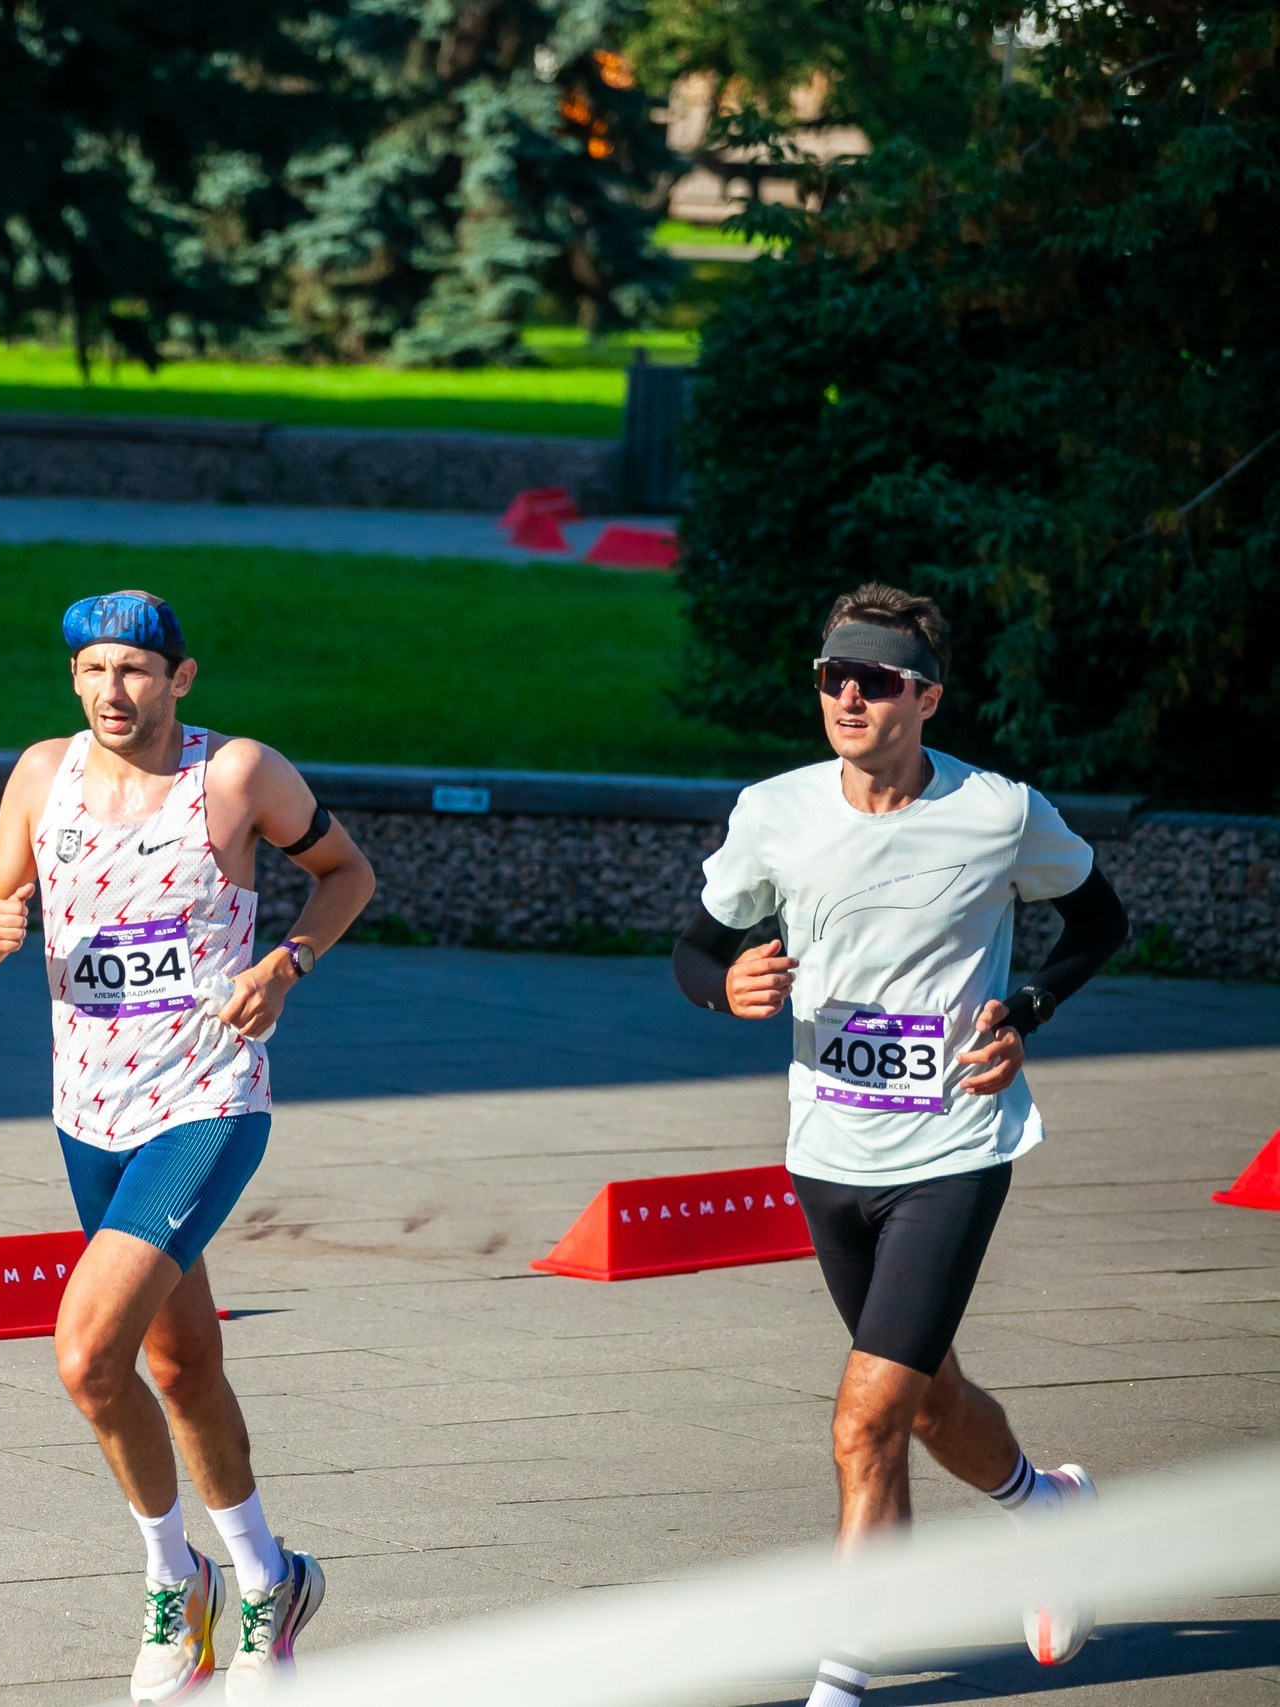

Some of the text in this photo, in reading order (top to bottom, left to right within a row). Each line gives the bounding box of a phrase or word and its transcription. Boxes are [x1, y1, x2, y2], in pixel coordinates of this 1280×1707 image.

[74, 947, 185, 989] 4034
[94, 987, 167, 999] КЛЕЗИС ВЛАДИМИР
[820, 1037, 937, 1080] 4083
[872, 1082, 910, 1090] АЛЕКСЕЙ
[620, 1192, 796, 1223] КРАСМАРАФ
